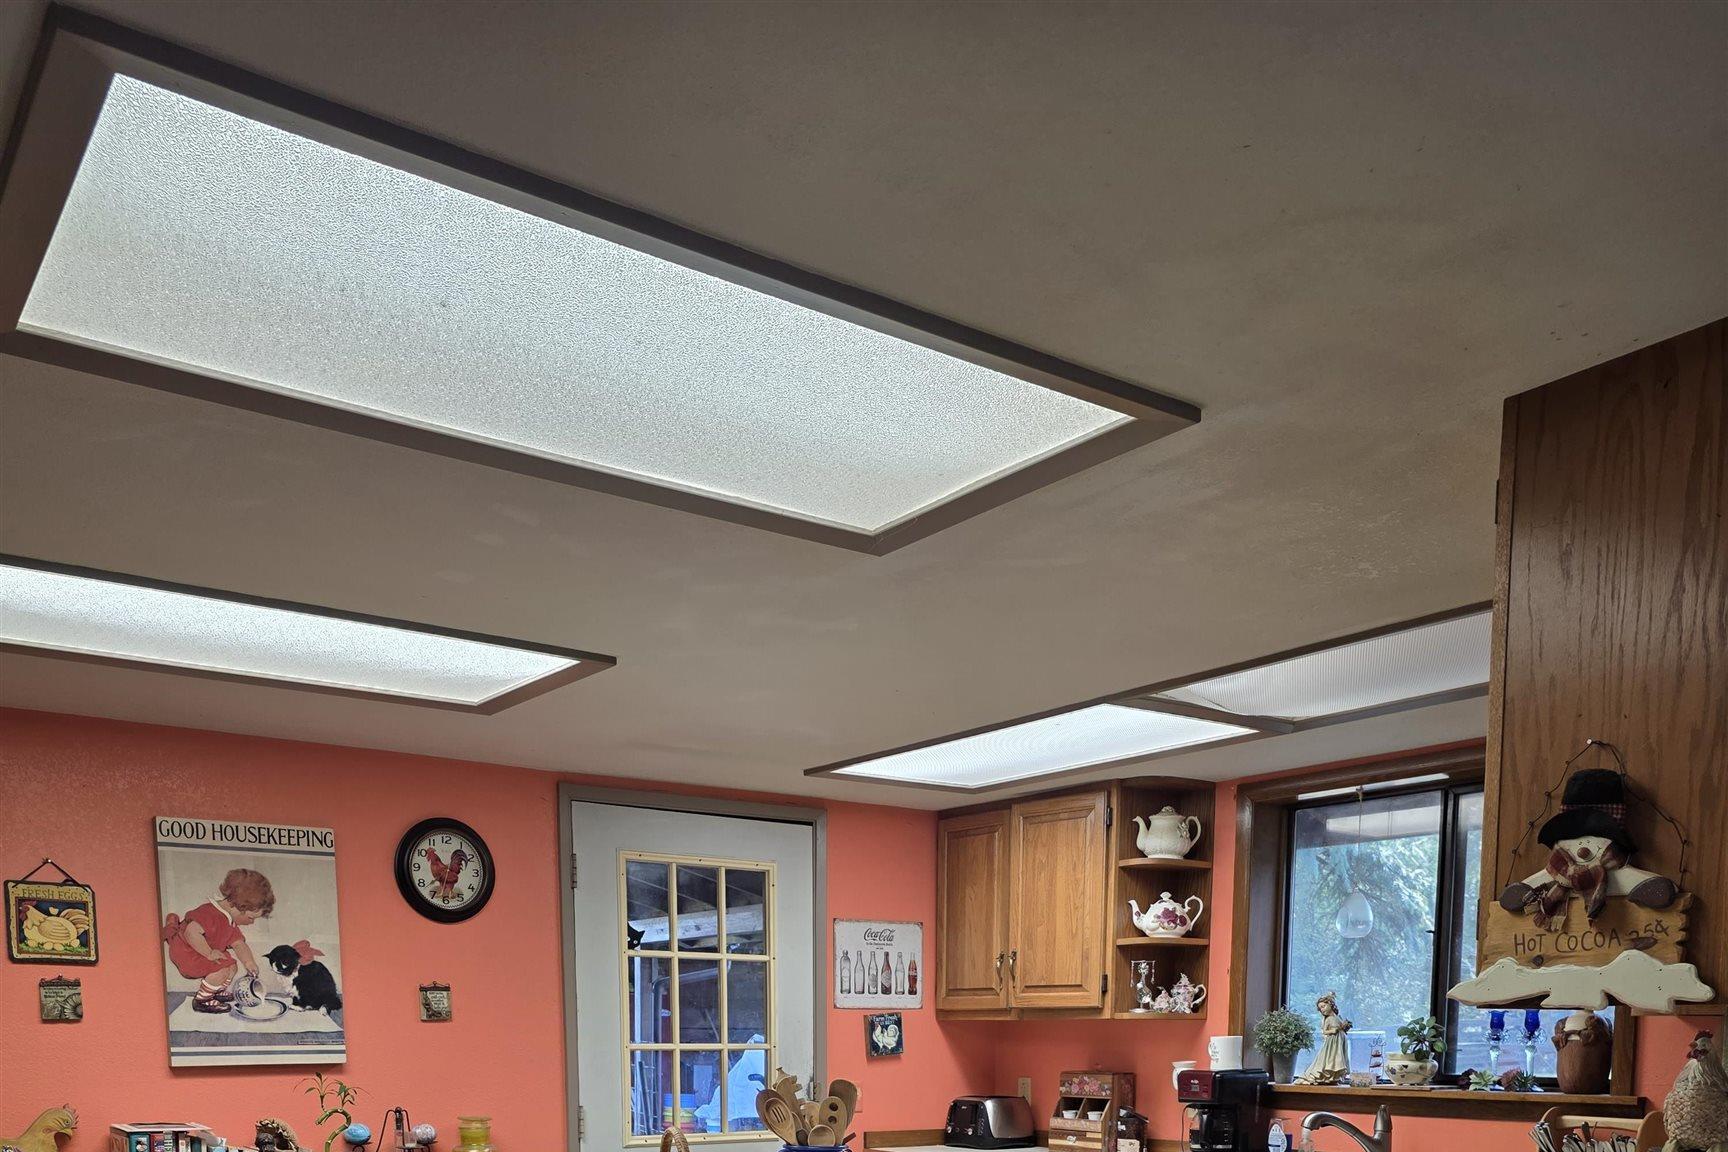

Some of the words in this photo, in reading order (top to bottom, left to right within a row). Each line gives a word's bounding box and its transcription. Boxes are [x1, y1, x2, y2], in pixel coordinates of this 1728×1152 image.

[159, 819, 206, 840] GOOD
[211, 823, 334, 849] HOUSEKEEPING
[441, 836, 452, 844] 12
[417, 849, 428, 858] 10
[467, 854, 475, 862] 2
[413, 863, 420, 872] 9
[472, 869, 480, 878] 3
[418, 879, 426, 888] 8
[468, 884, 475, 892] 4
[22, 888, 55, 899] FRESH
[58, 890, 85, 900] EGGS
[429, 890, 437, 900] 7
[456, 894, 464, 902] 5
[442, 896, 450, 904] 6
[1513, 933, 1546, 956] HOT
[1555, 928, 1622, 954] COCOA
